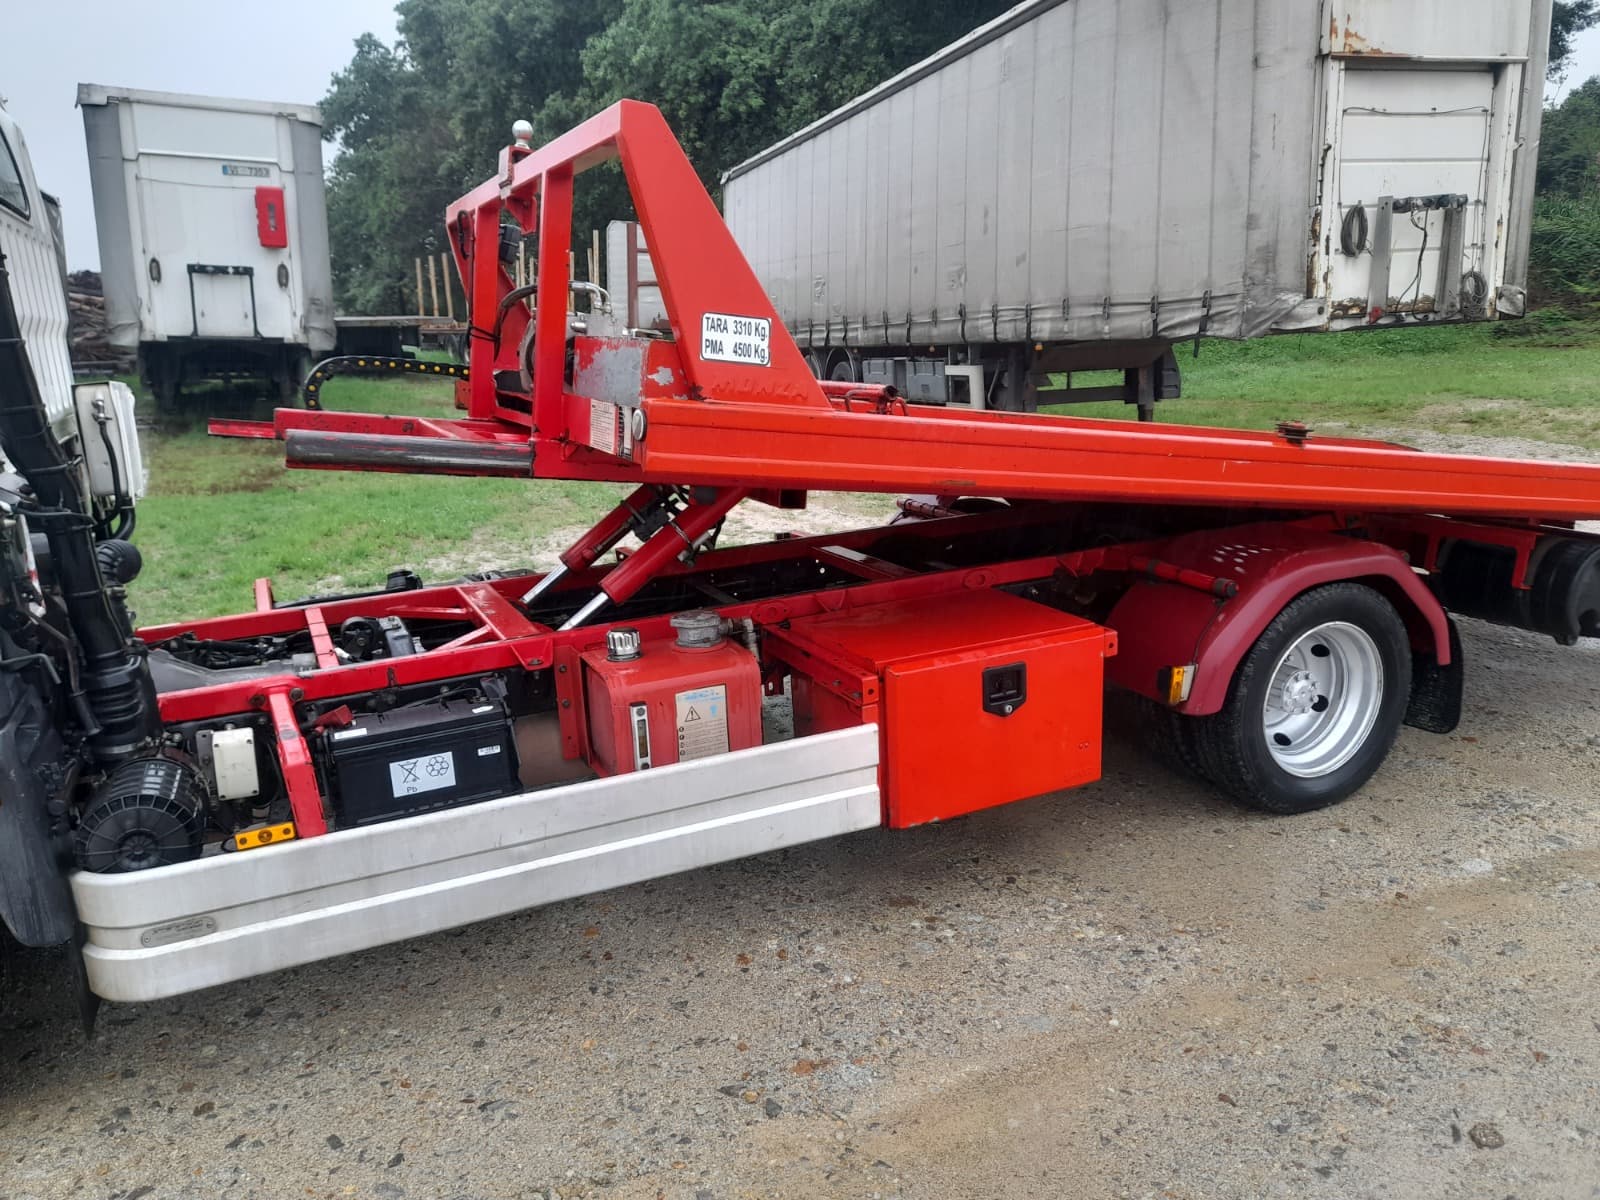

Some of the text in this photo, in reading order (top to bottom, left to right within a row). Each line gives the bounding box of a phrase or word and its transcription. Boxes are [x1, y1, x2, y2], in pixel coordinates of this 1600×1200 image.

[705, 317, 728, 334] TARA
[733, 320, 752, 336] 3310
[704, 339, 724, 355] PMA
[732, 342, 752, 358] 4500
